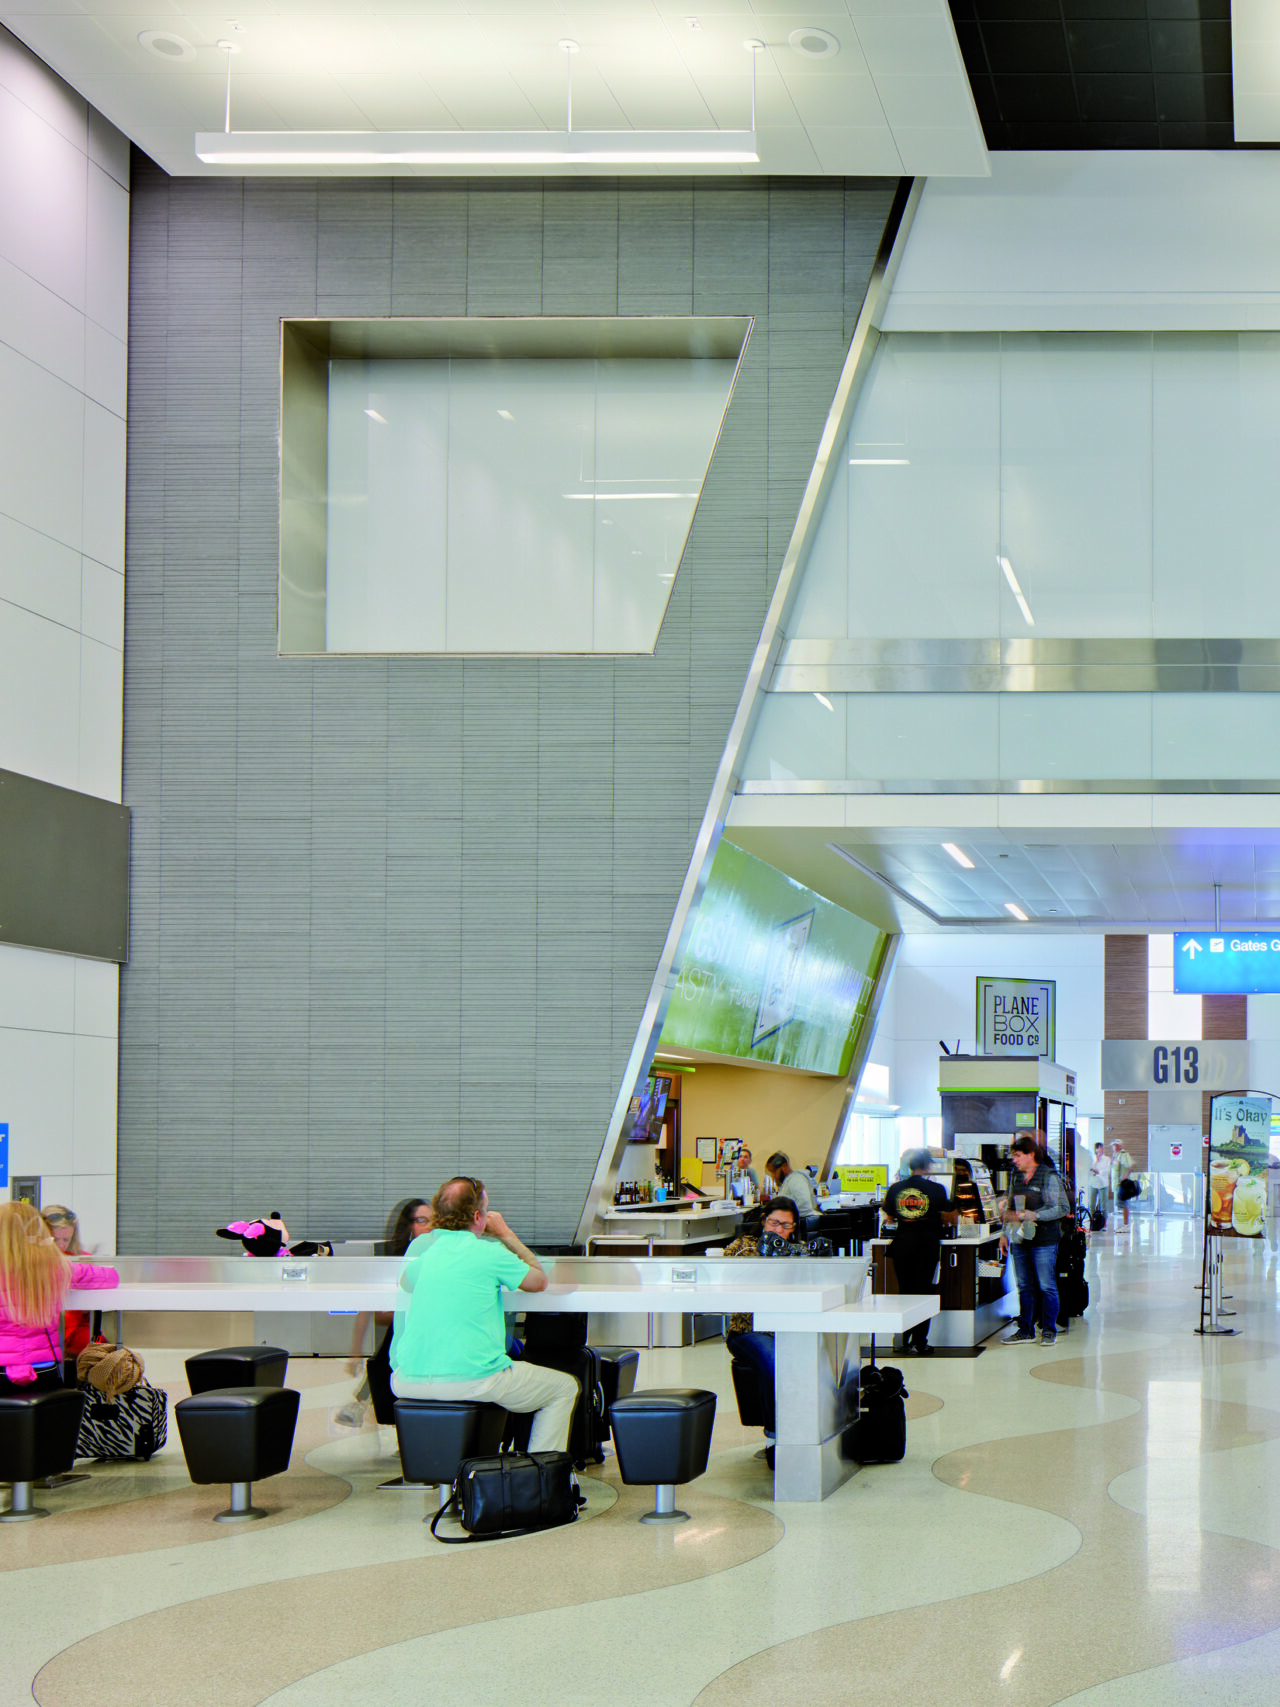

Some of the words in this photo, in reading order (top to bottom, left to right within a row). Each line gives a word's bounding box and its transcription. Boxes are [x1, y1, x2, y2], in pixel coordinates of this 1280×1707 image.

[1230, 939, 1268, 952] Gates
[993, 995, 1039, 1015] PLANE
[993, 1014, 1039, 1033] BOX
[993, 1033, 1023, 1046] FOOD
[1153, 1045, 1199, 1084] G13
[1236, 1108, 1268, 1126] Okay
